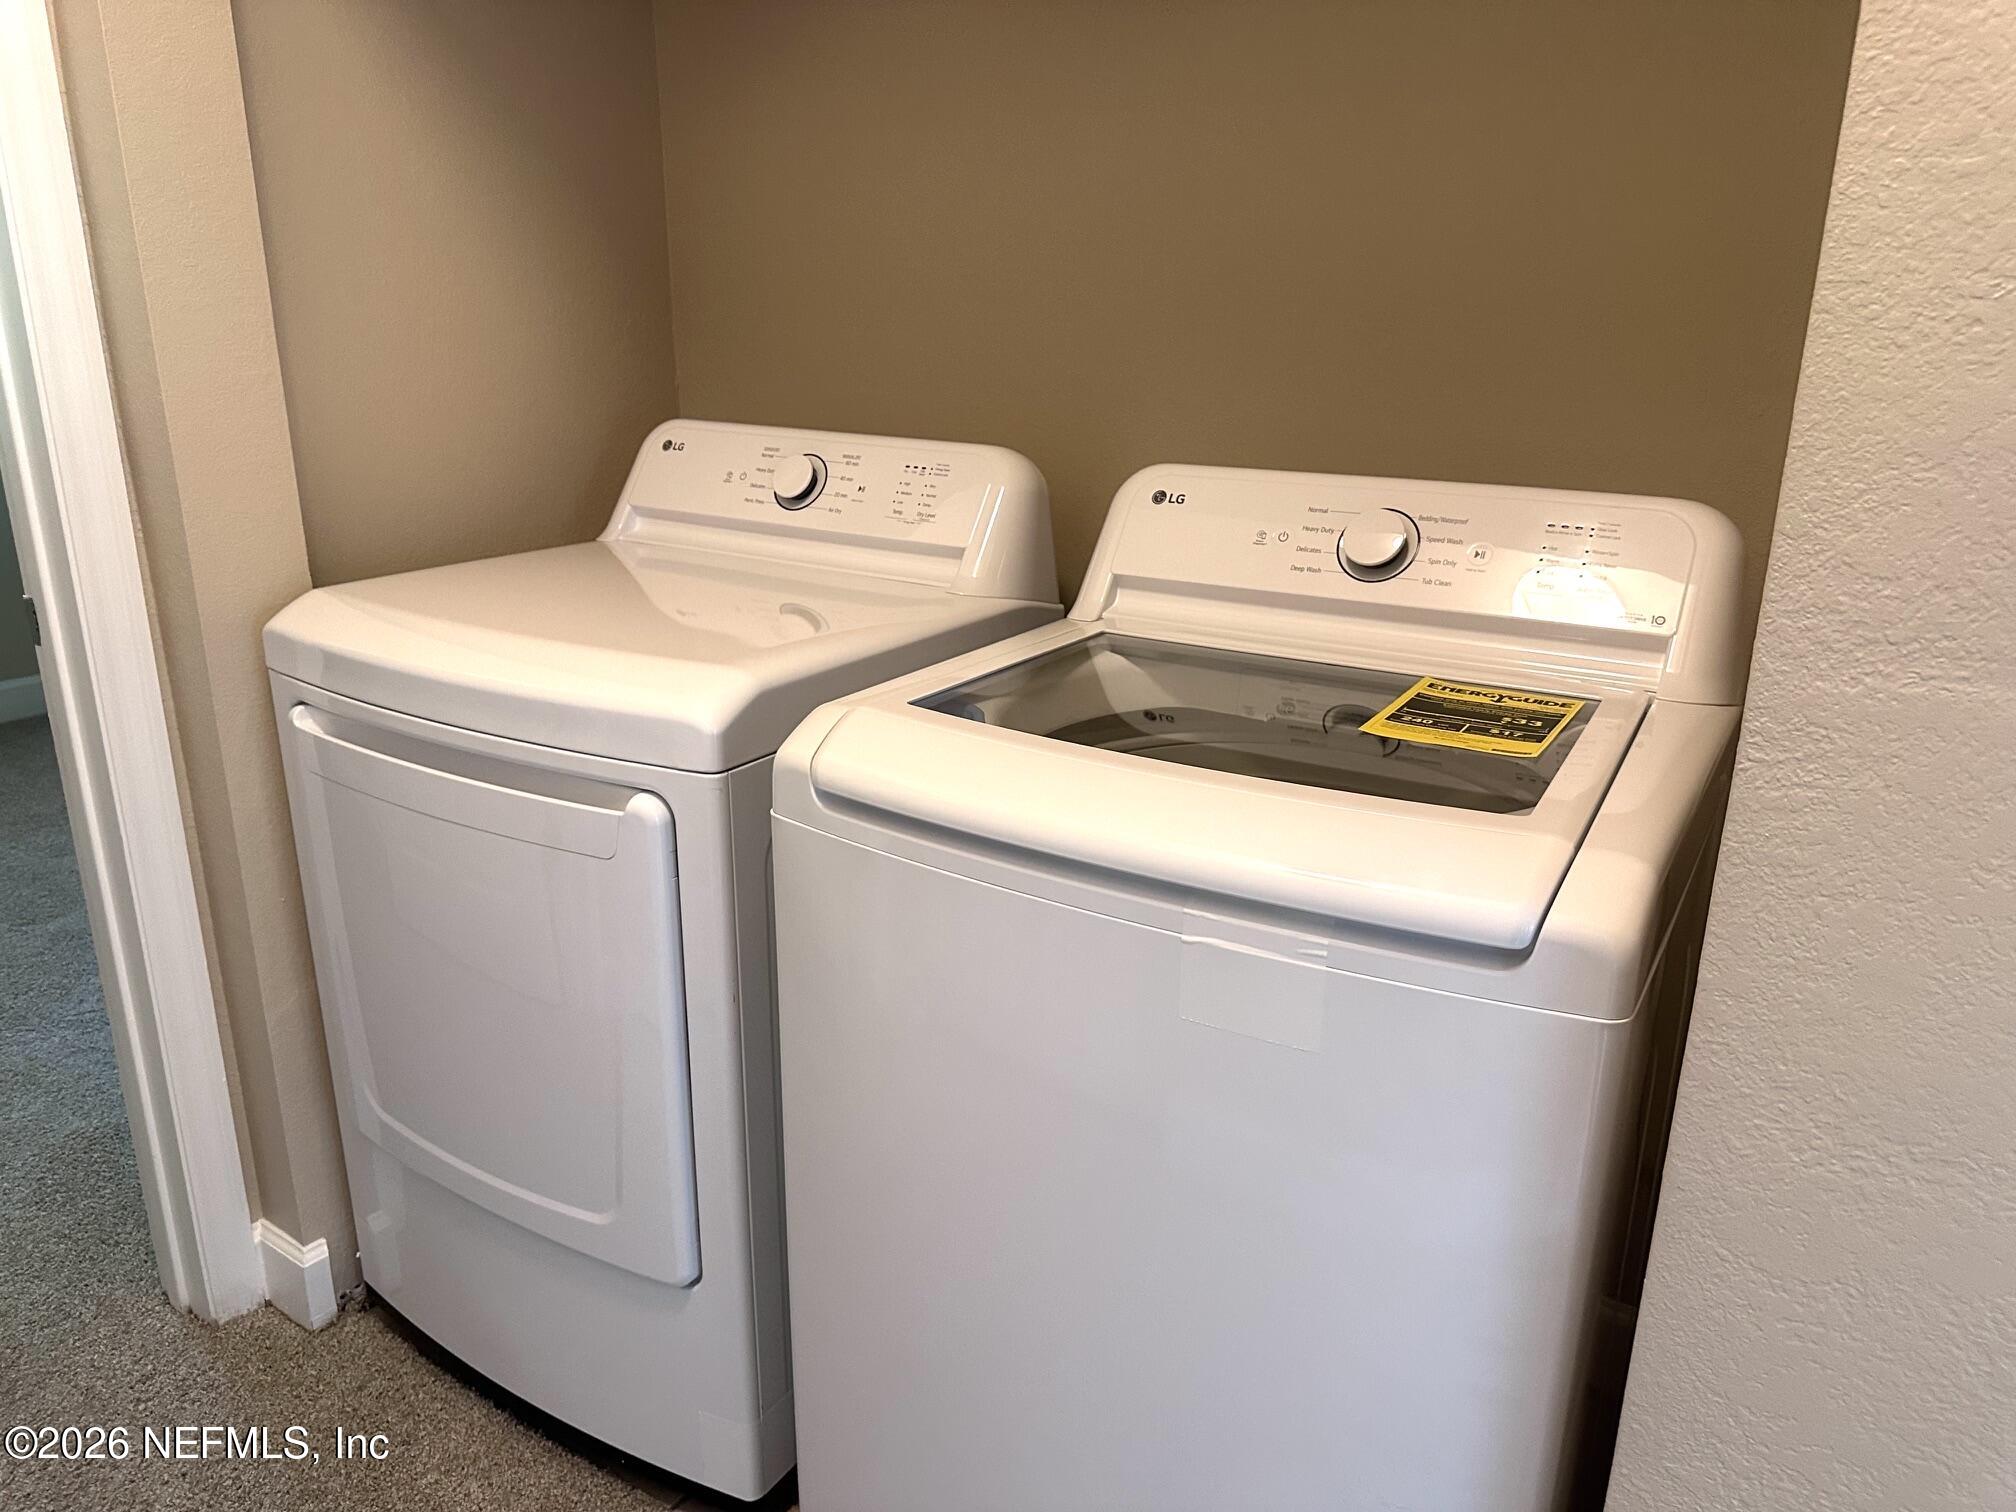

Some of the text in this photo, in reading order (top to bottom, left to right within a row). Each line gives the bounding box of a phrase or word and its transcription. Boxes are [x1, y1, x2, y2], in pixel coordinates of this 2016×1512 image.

[1168, 493, 1186, 504] LG
[1307, 506, 1329, 514] Normal
[1302, 525, 1335, 535] Heavy Duty
[1426, 535, 1464, 546] Speed Wash
[1295, 545, 1322, 554] Delicates
[1427, 557, 1457, 568] Spin Only
[1290, 564, 1322, 574] Deep Wash
[1422, 577, 1452, 587] Tub Clean
[1427, 682, 1576, 710] ENERGYGUIDE
[1400, 715, 1433, 725] 240
